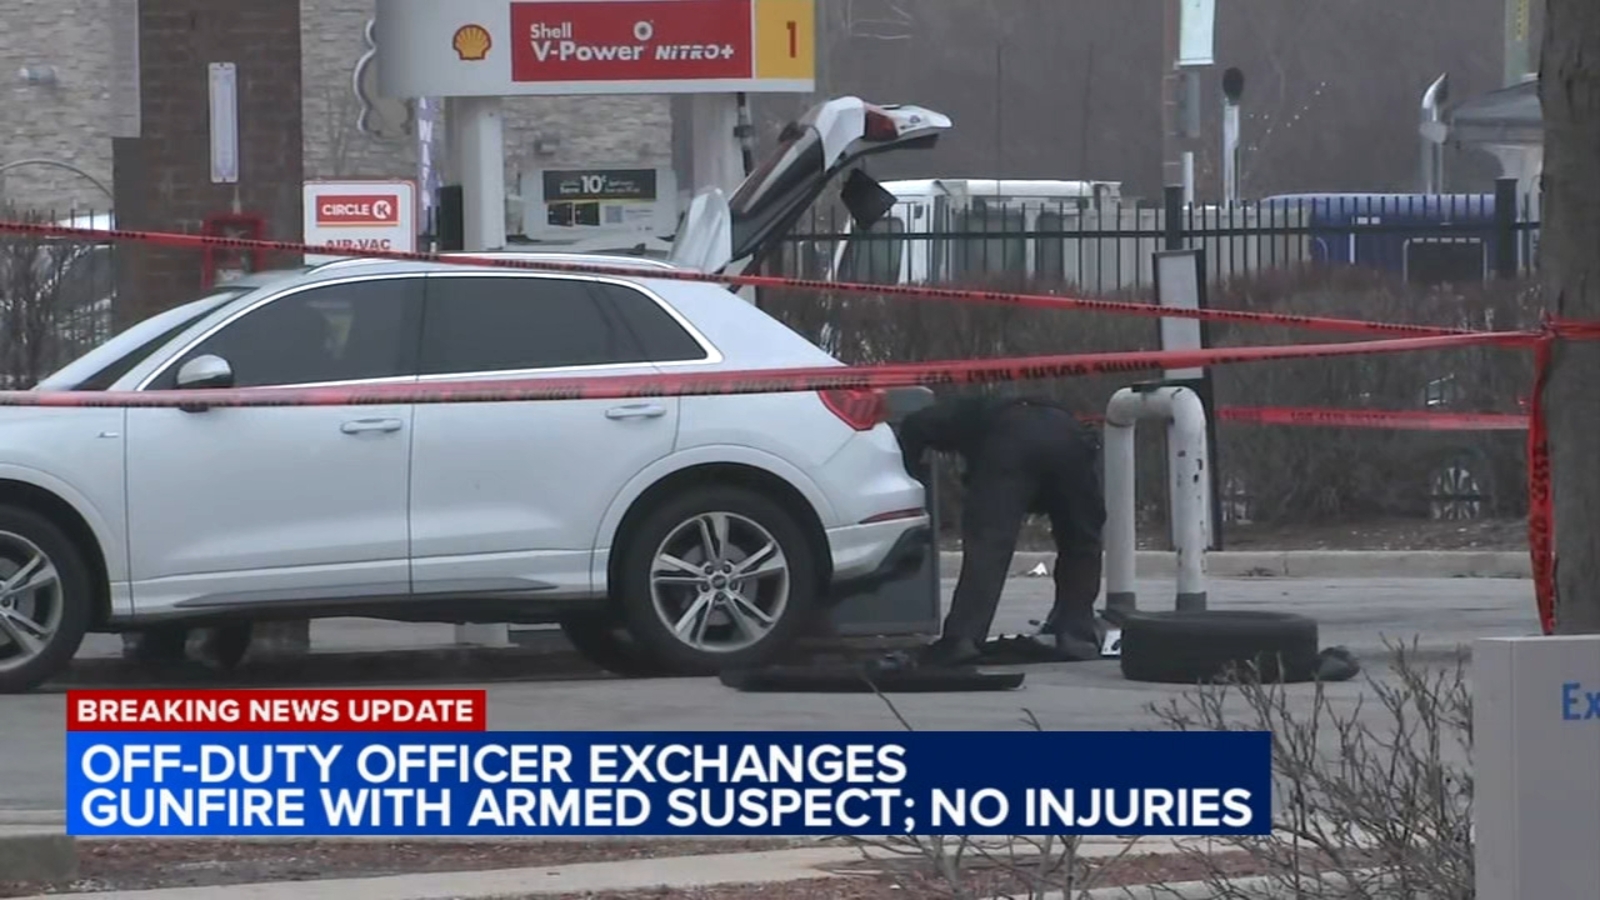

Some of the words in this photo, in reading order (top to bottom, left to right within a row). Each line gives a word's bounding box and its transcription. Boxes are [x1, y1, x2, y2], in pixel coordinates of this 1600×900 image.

[530, 22, 572, 39] Shell
[786, 21, 797, 58] 1
[531, 41, 644, 61] V-Power
[322, 204, 371, 216] CIRCLE
[374, 201, 391, 219] K
